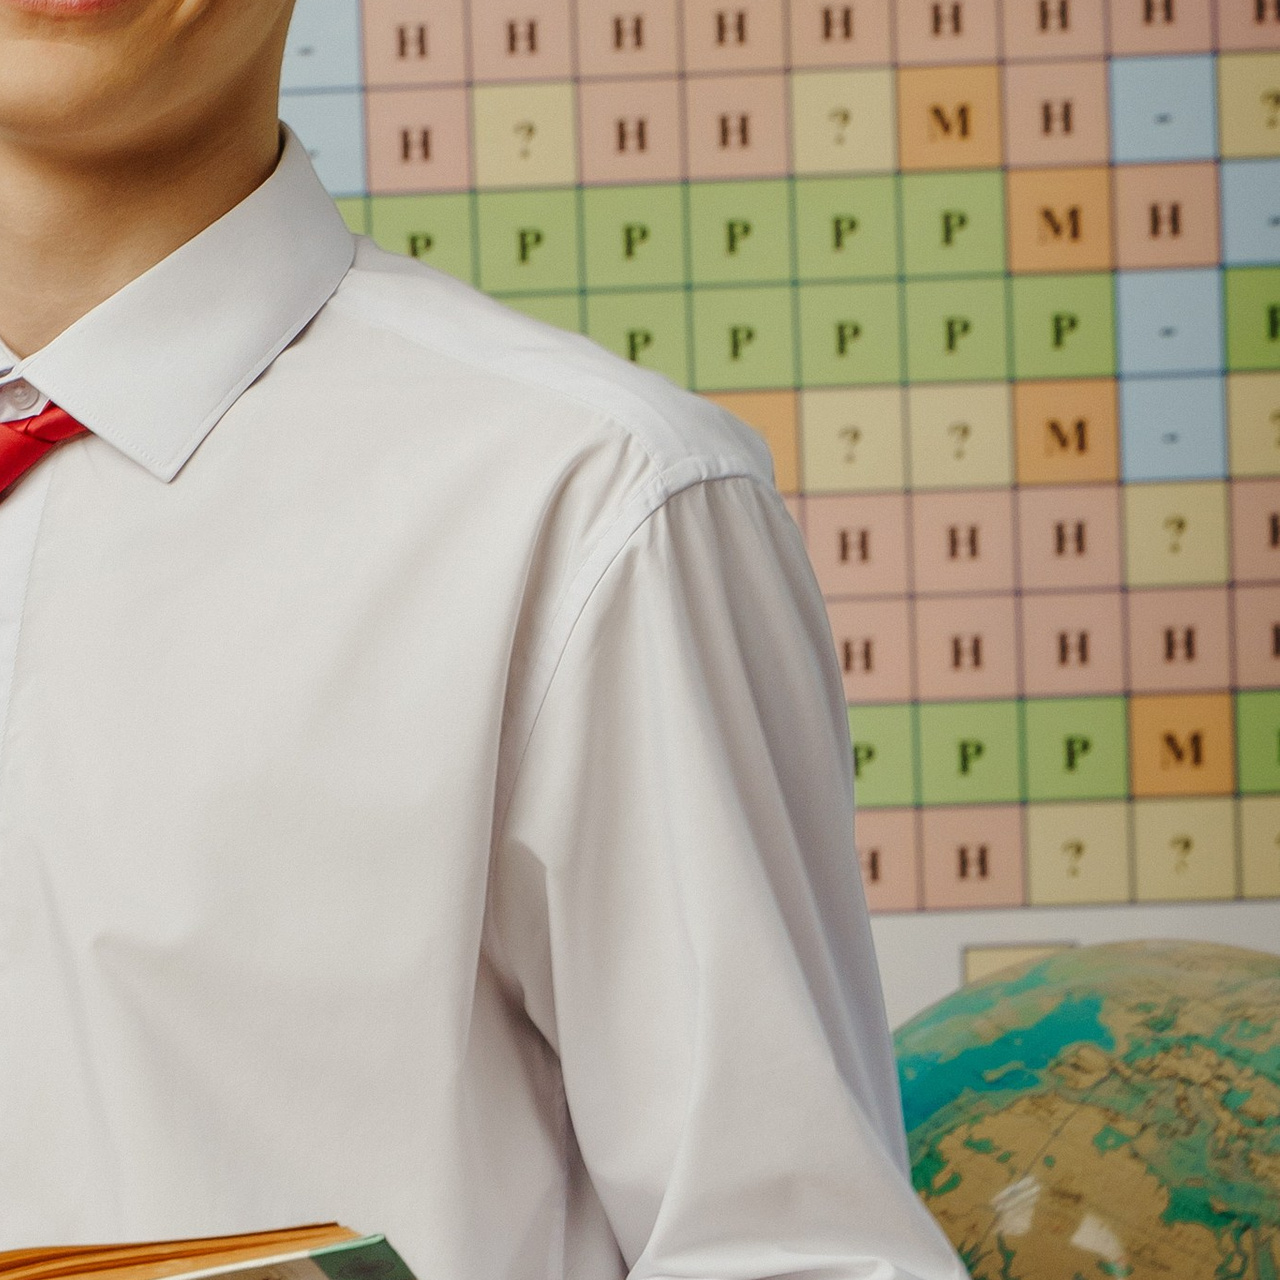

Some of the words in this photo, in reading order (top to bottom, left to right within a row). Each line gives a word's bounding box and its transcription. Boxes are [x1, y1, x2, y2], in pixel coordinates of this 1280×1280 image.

[400, 127, 432, 163] Н
[615, 118, 648, 154] Н
[718, 113, 750, 149] Н
[930, 103, 971, 140] М
[1041, 99, 1074, 136] Н
[957, 844, 990, 881] Н
